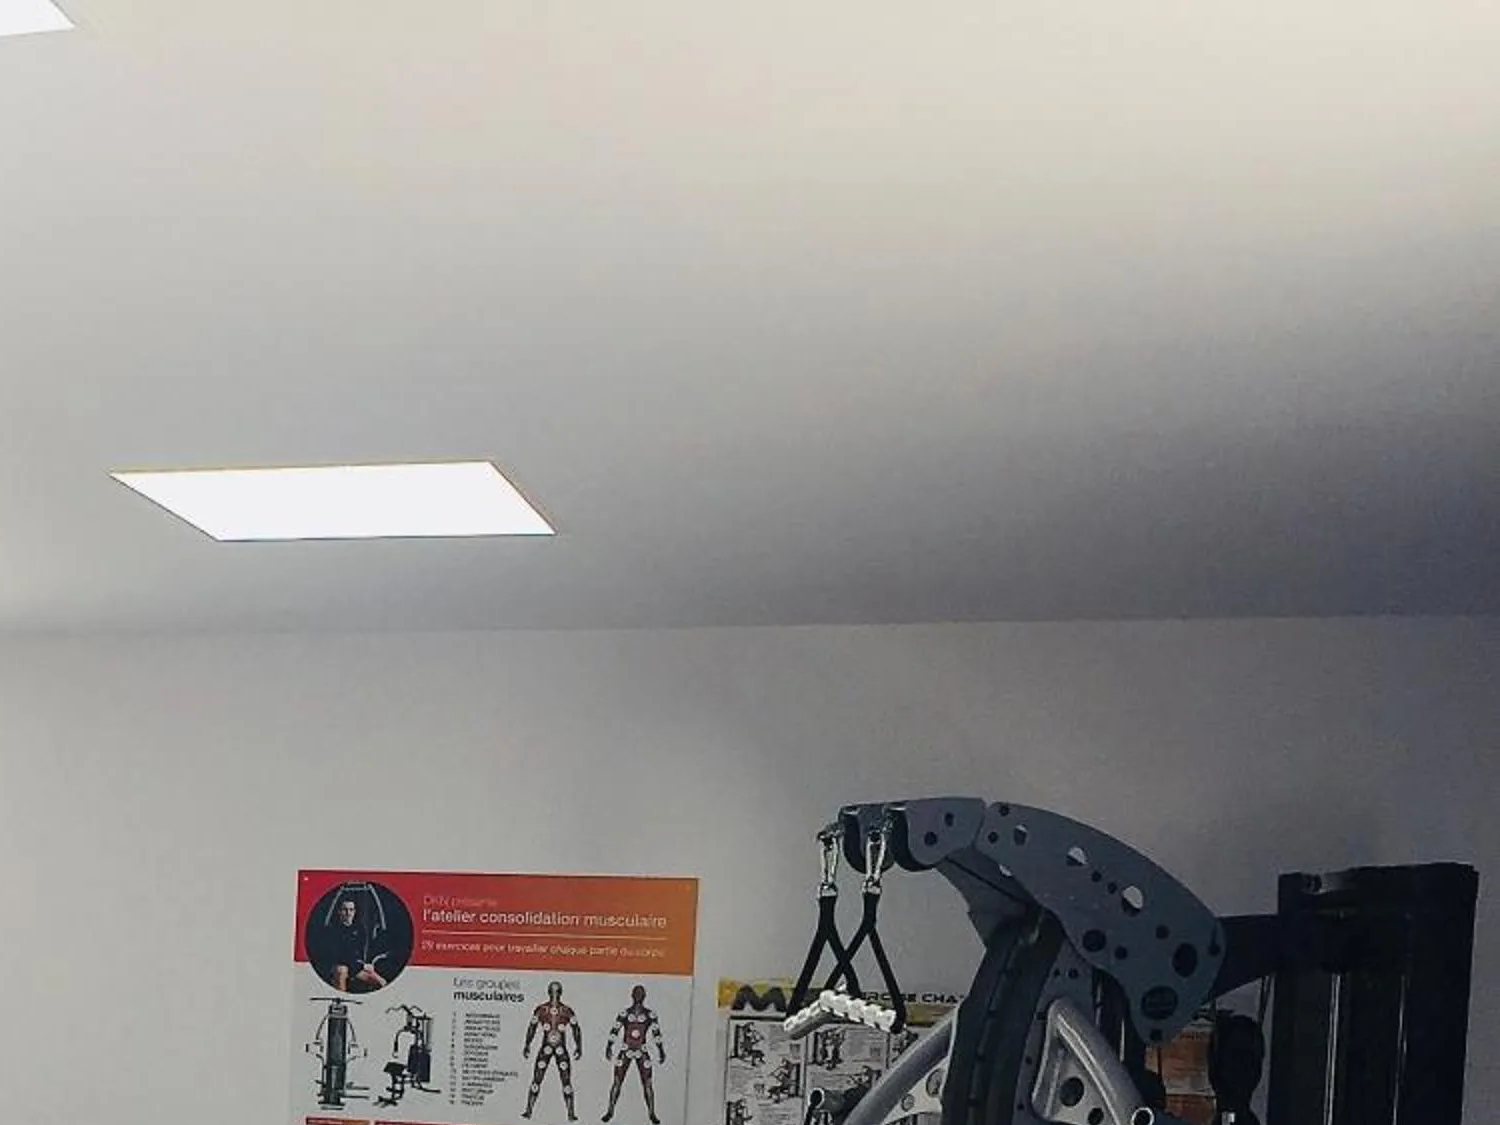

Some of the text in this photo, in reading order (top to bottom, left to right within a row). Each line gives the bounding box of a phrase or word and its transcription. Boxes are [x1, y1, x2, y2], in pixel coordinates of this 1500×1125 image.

[479, 911, 580, 926] consolidation
[584, 914, 667, 929] musculaire
[453, 991, 525, 1003] musculaires
